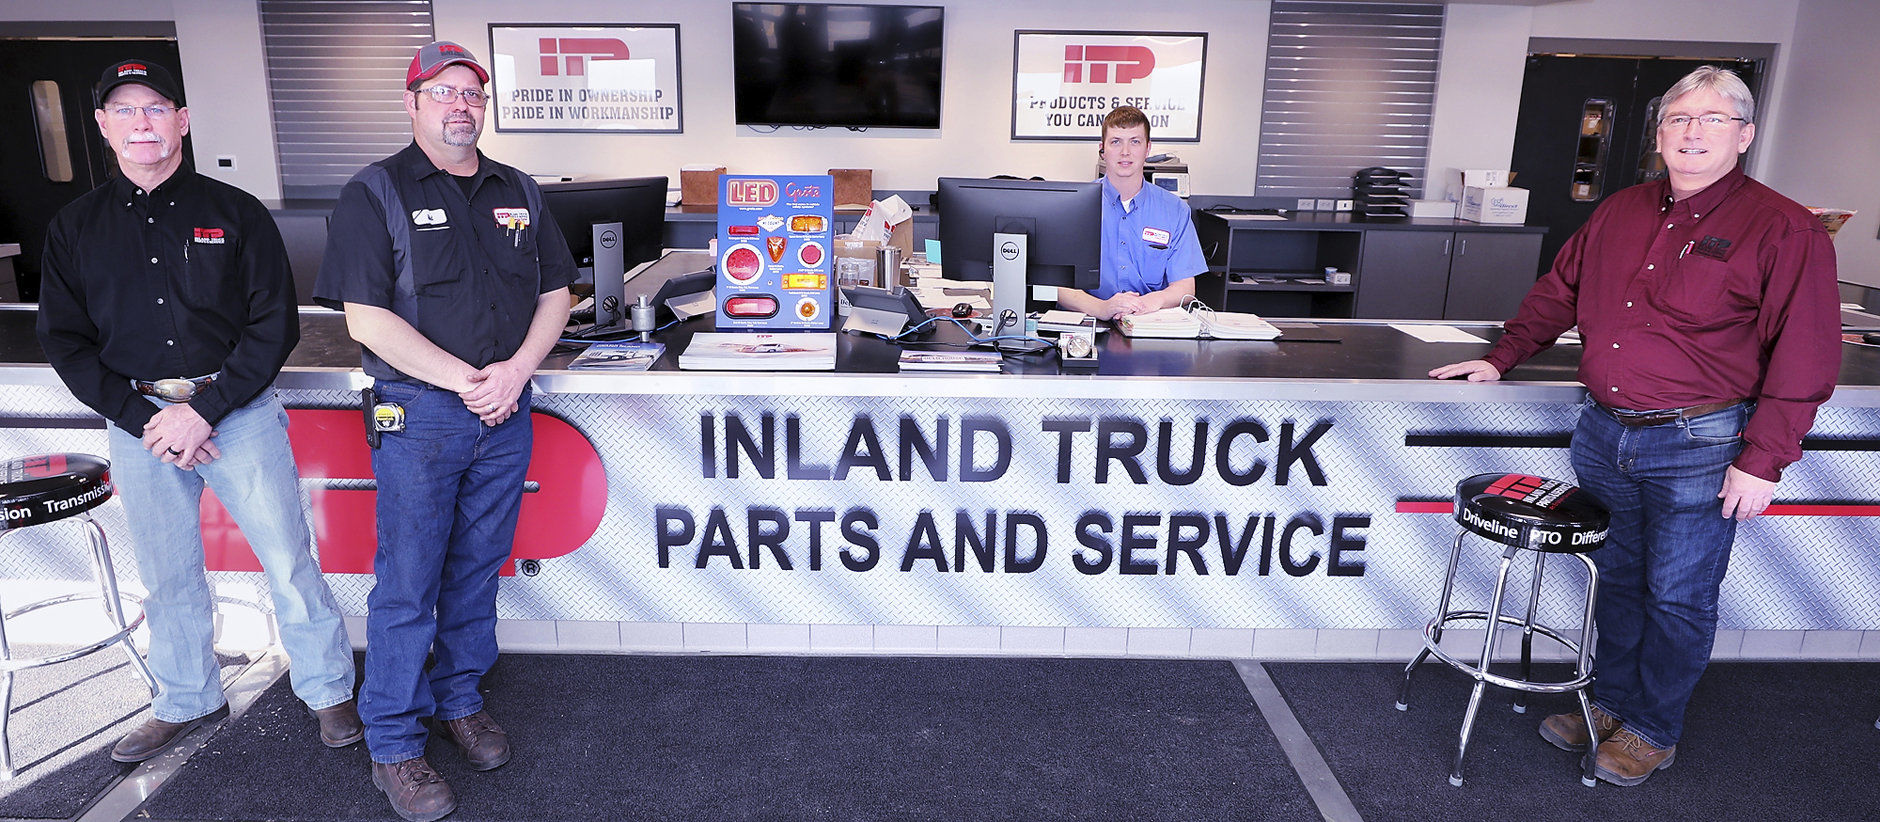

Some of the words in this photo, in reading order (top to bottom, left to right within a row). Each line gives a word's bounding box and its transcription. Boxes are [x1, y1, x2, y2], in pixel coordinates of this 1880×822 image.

[1063, 45, 1155, 83] ITP
[511, 89, 554, 102] PRIDE
[559, 89, 573, 102] IN
[578, 89, 663, 102] OWNERSHIP
[1111, 96, 1120, 110] &
[502, 106, 544, 119] PRIDE
[550, 106, 564, 119] IN
[569, 107, 674, 120] WORKMANSHIP
[1046, 113, 1072, 126] YOU
[1077, 113, 1104, 127] CAN
[1151, 115, 1169, 127] ON
[731, 182, 775, 202] LED
[785, 182, 820, 202] Grote
[701, 414, 1012, 482] INLAND
[1041, 419, 1335, 487] TRUCK
[1463, 508, 1519, 539] Driveline
[1529, 529, 1562, 545] PTO
[655, 506, 880, 573] PARTS
[900, 511, 1048, 574] AND
[1072, 513, 1372, 578] SERVICE
